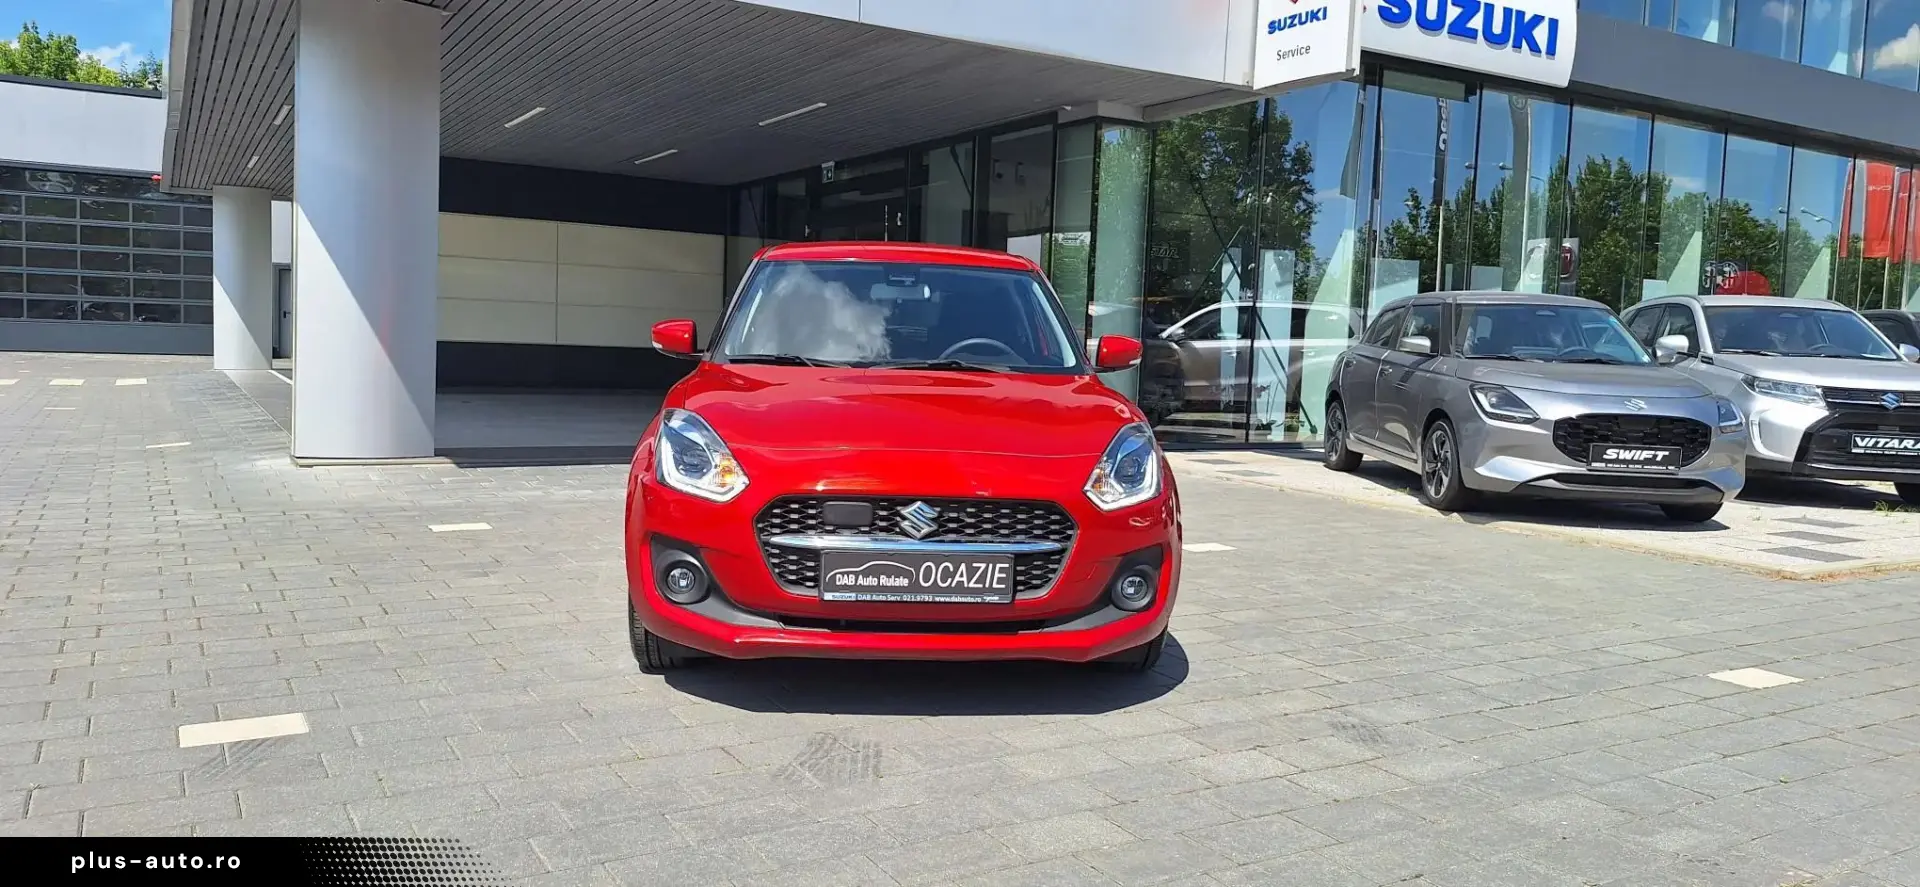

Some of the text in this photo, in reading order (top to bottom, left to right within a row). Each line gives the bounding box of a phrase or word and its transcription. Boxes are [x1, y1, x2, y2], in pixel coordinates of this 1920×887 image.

[1267, 6, 1328, 35] SUZUKI
[1378, 0, 1559, 56] SUZUKI
[1276, 44, 1311, 61] Service
[1602, 448, 1670, 462] SWIFT
[835, 574, 909, 587] DAB Auto Rulate
[919, 561, 1010, 589] OCAZIE
[857, 593, 871, 601] DAB
[887, 594, 901, 602] Serv
